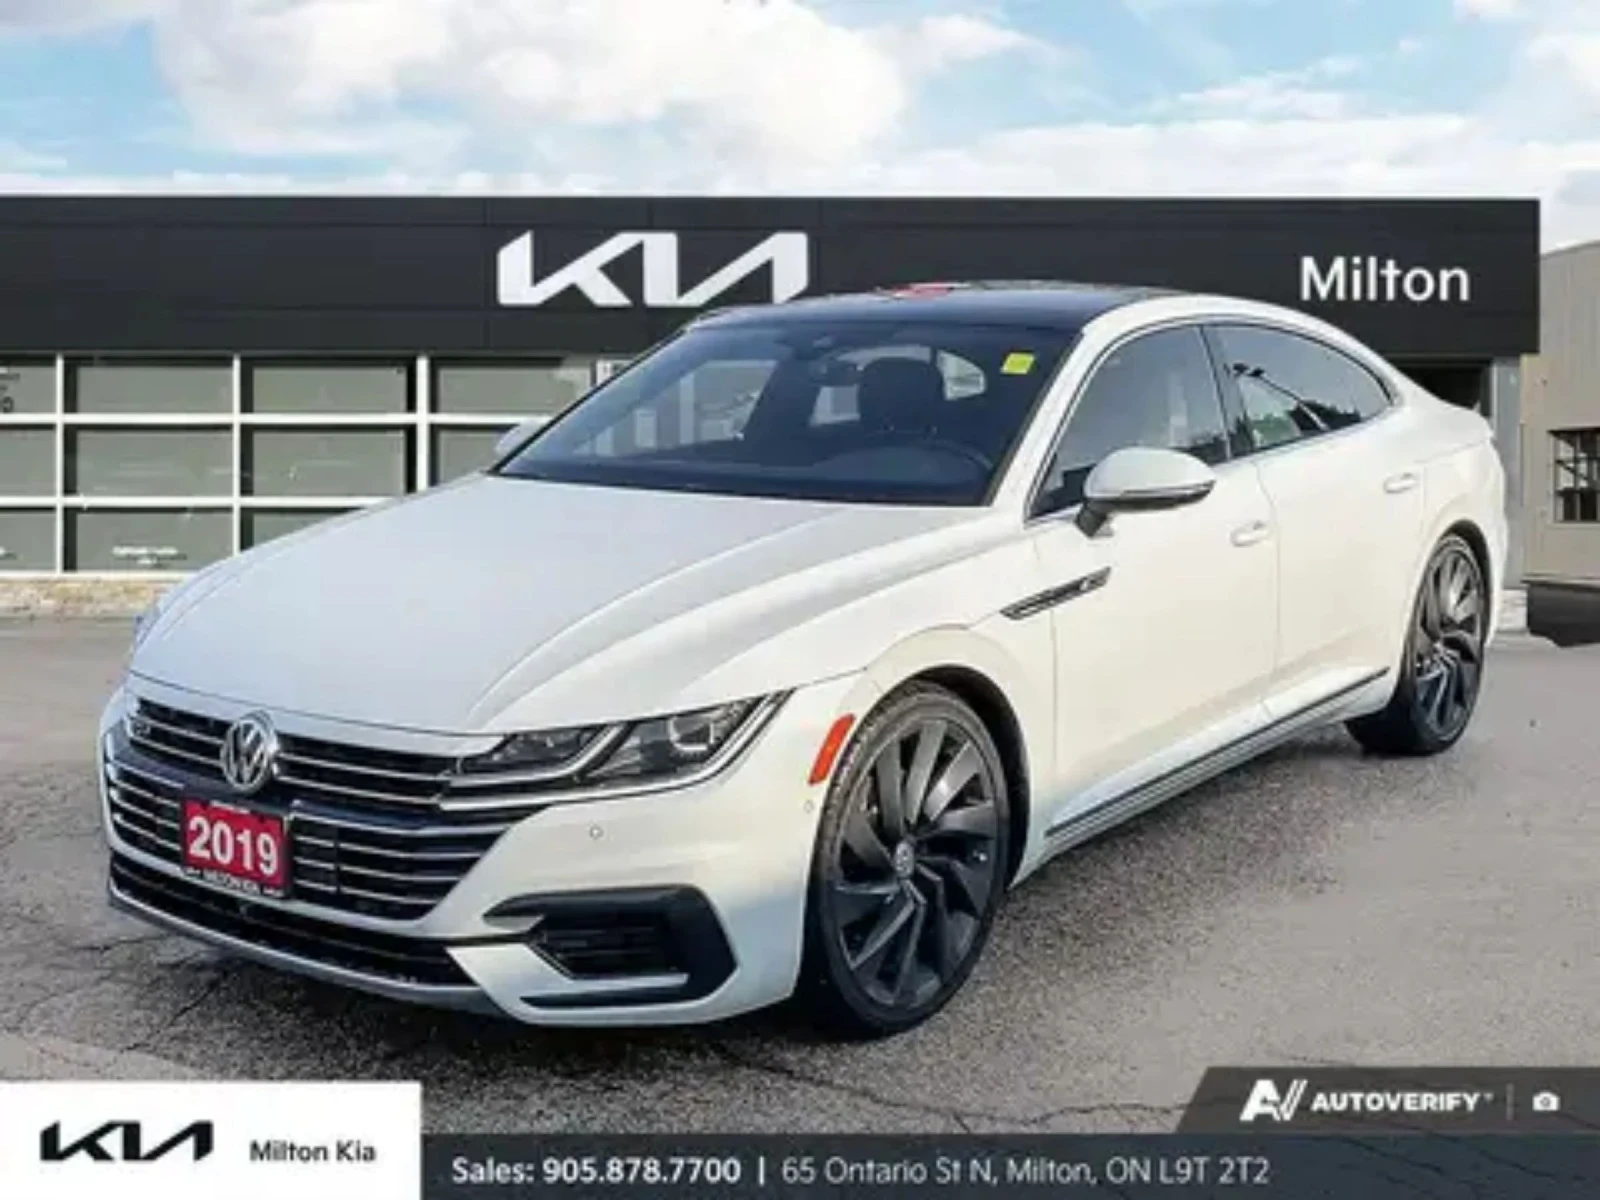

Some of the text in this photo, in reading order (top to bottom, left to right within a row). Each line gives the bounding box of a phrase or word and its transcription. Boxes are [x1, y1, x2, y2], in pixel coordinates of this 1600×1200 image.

[497, 230, 808, 307] KIA
[1301, 256, 1469, 301] Milton
[187, 815, 279, 877] 2019
